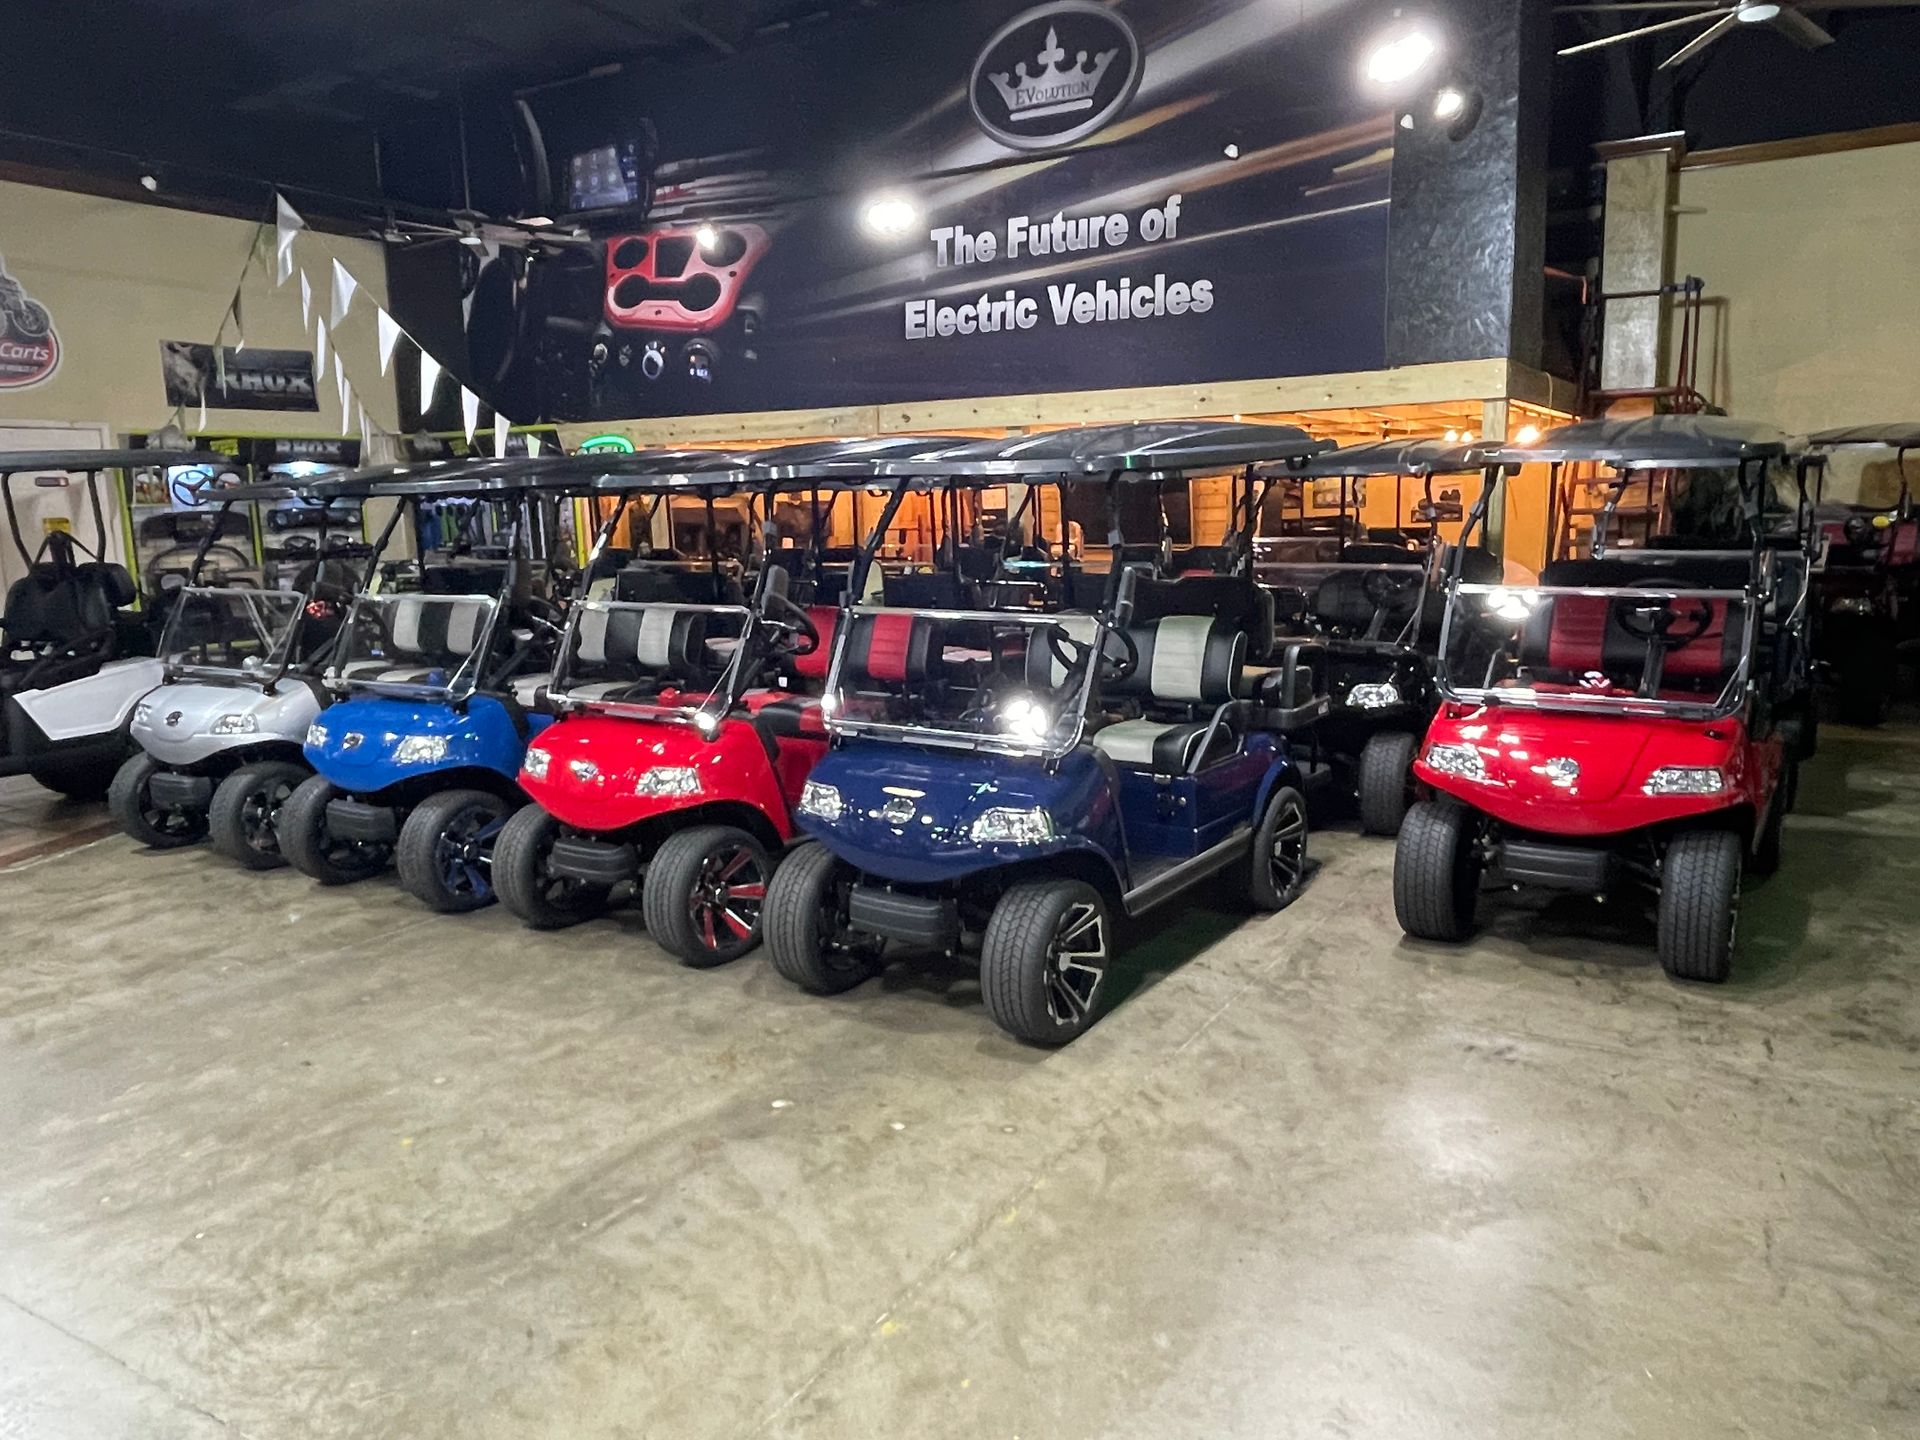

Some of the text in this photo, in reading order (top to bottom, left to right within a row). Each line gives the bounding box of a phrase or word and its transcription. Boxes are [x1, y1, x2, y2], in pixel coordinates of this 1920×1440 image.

[930, 194, 1182, 268] The Future of
[904, 273, 1214, 340] Electric Vehicles
[0, 342, 49, 360] Carts
